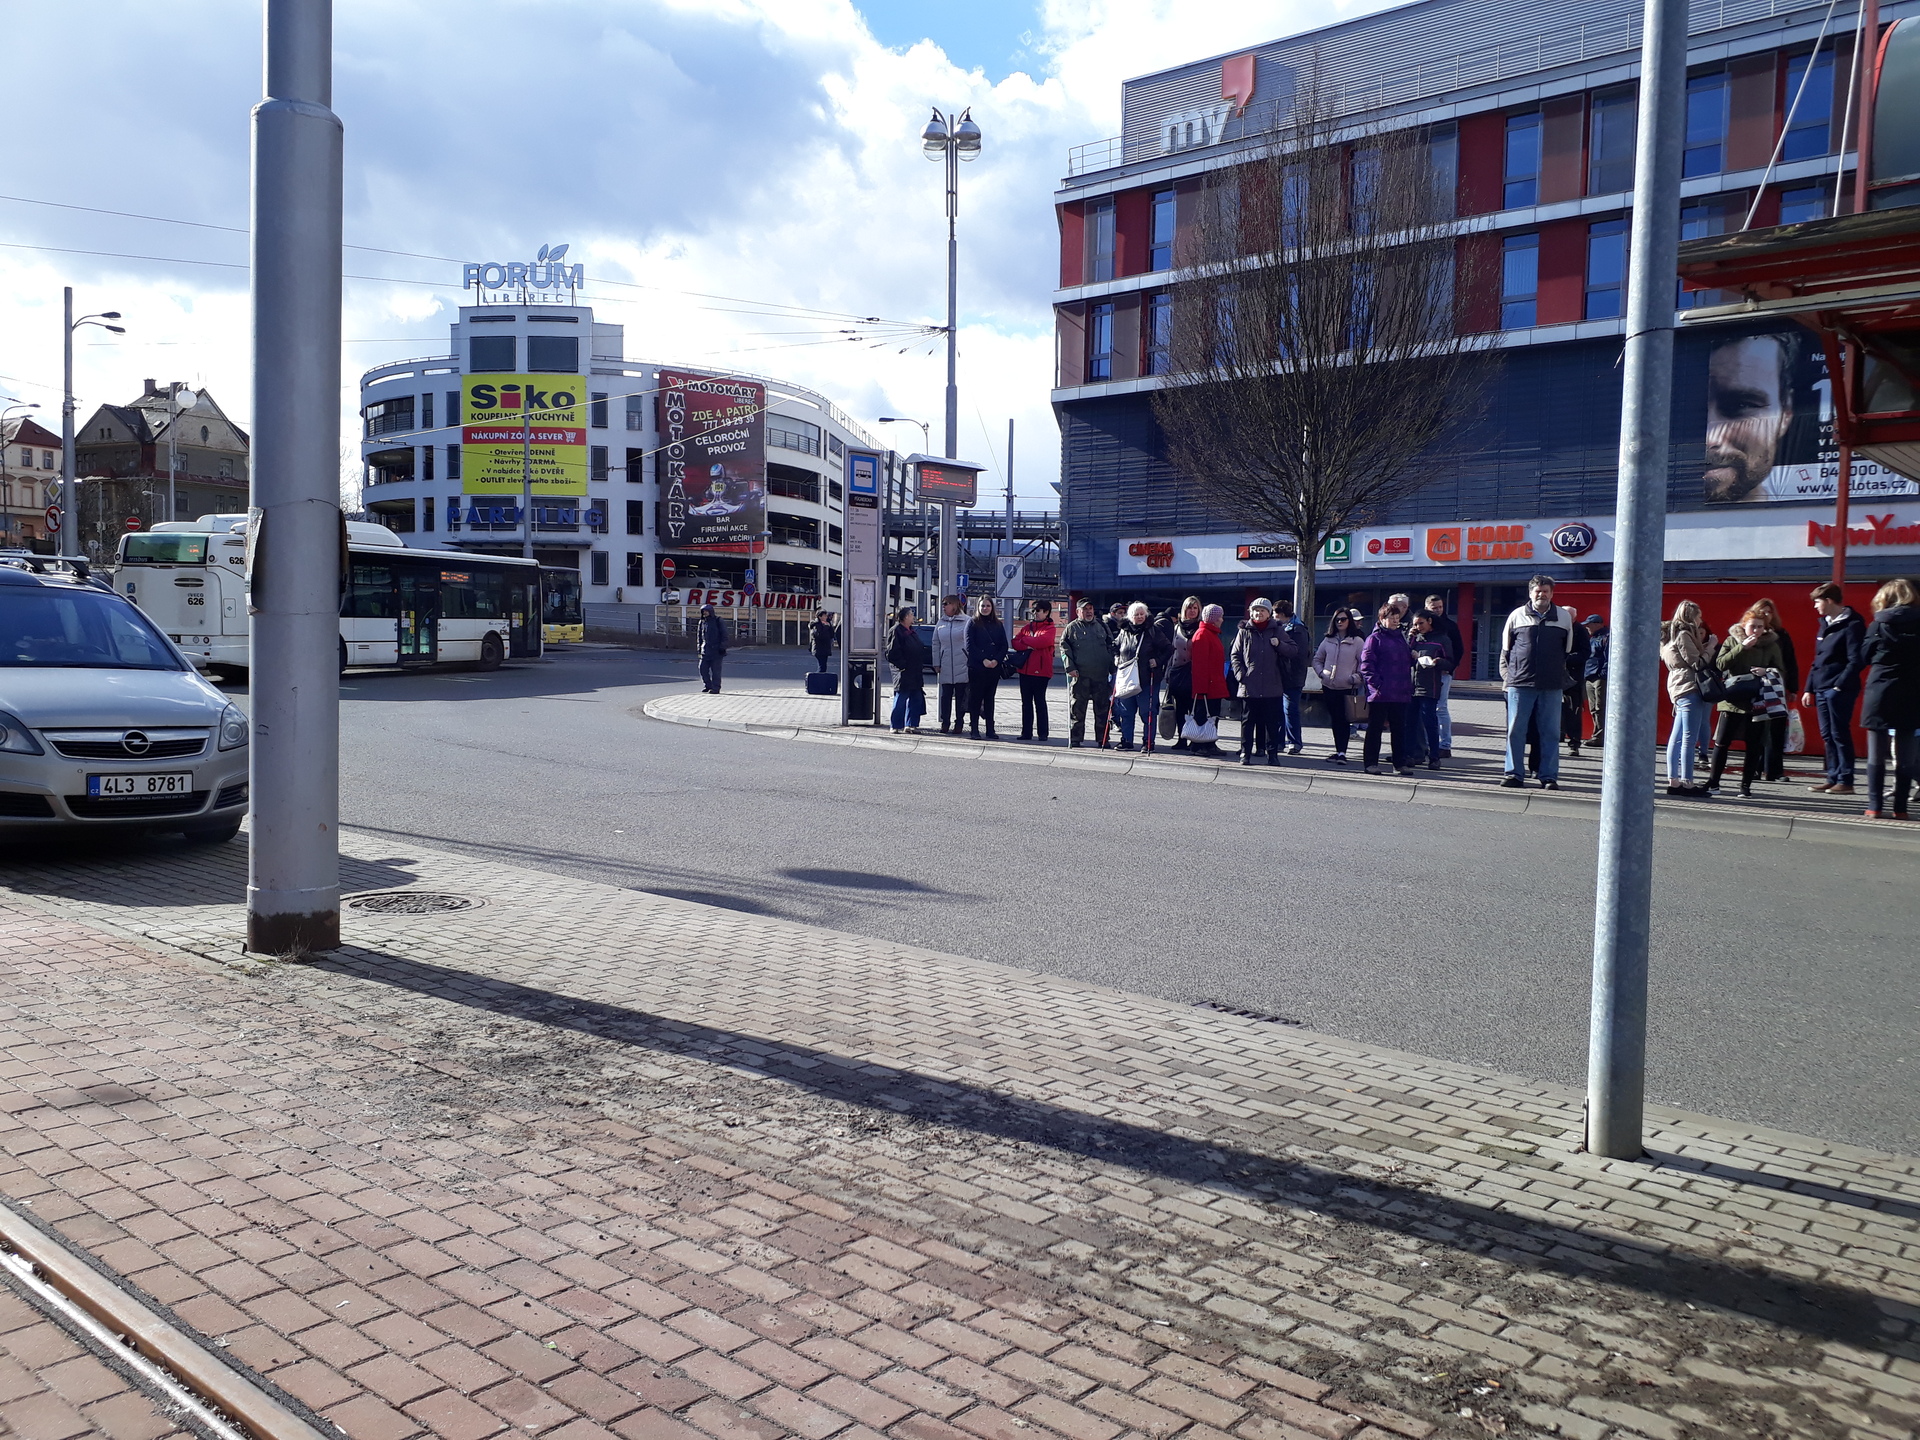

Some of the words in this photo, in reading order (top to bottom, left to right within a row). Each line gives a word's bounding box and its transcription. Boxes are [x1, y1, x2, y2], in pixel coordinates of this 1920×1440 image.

[463, 262, 583, 289] FORUM
[482, 293, 564, 303] LIBEREC
[687, 380, 757, 398] MOTOKÁRY
[471, 413, 518, 421] KOUPELNY
[529, 411, 575, 421] KUCHYNĚ
[692, 410, 713, 421] ZDE
[716, 409, 725, 419] 4.
[726, 404, 759, 417] PATRO
[702, 419, 718, 430] 777
[471, 430, 509, 439] NÁKUPNÍ
[511, 431, 536, 440] ZÓA
[538, 432, 563, 441] SEVER
[695, 428, 750, 446] CELOROČNÍ
[530, 448, 556, 456] DENNĚ
[707, 441, 747, 456] PROVOZ
[665, 391, 686, 538] MOTOKÁRY
[447, 506, 603, 526] PARKING
[701, 525, 729, 533] FIREMNÍ
[730, 524, 748, 532] AKCE
[1467, 525, 1525, 543] NORD
[692, 536, 719, 544] OSLAVY
[1329, 537, 1346, 555] D
[1557, 531, 1587, 548] C&A
[1128, 541, 1175, 556] CINEMA
[1467, 542, 1533, 561] BLANC
[229, 556, 245, 565] 626
[1146, 554, 1175, 568] CITY
[187, 598, 205, 606] 626
[104, 777, 135, 794] 4L3
[147, 776, 185, 792] 8781
